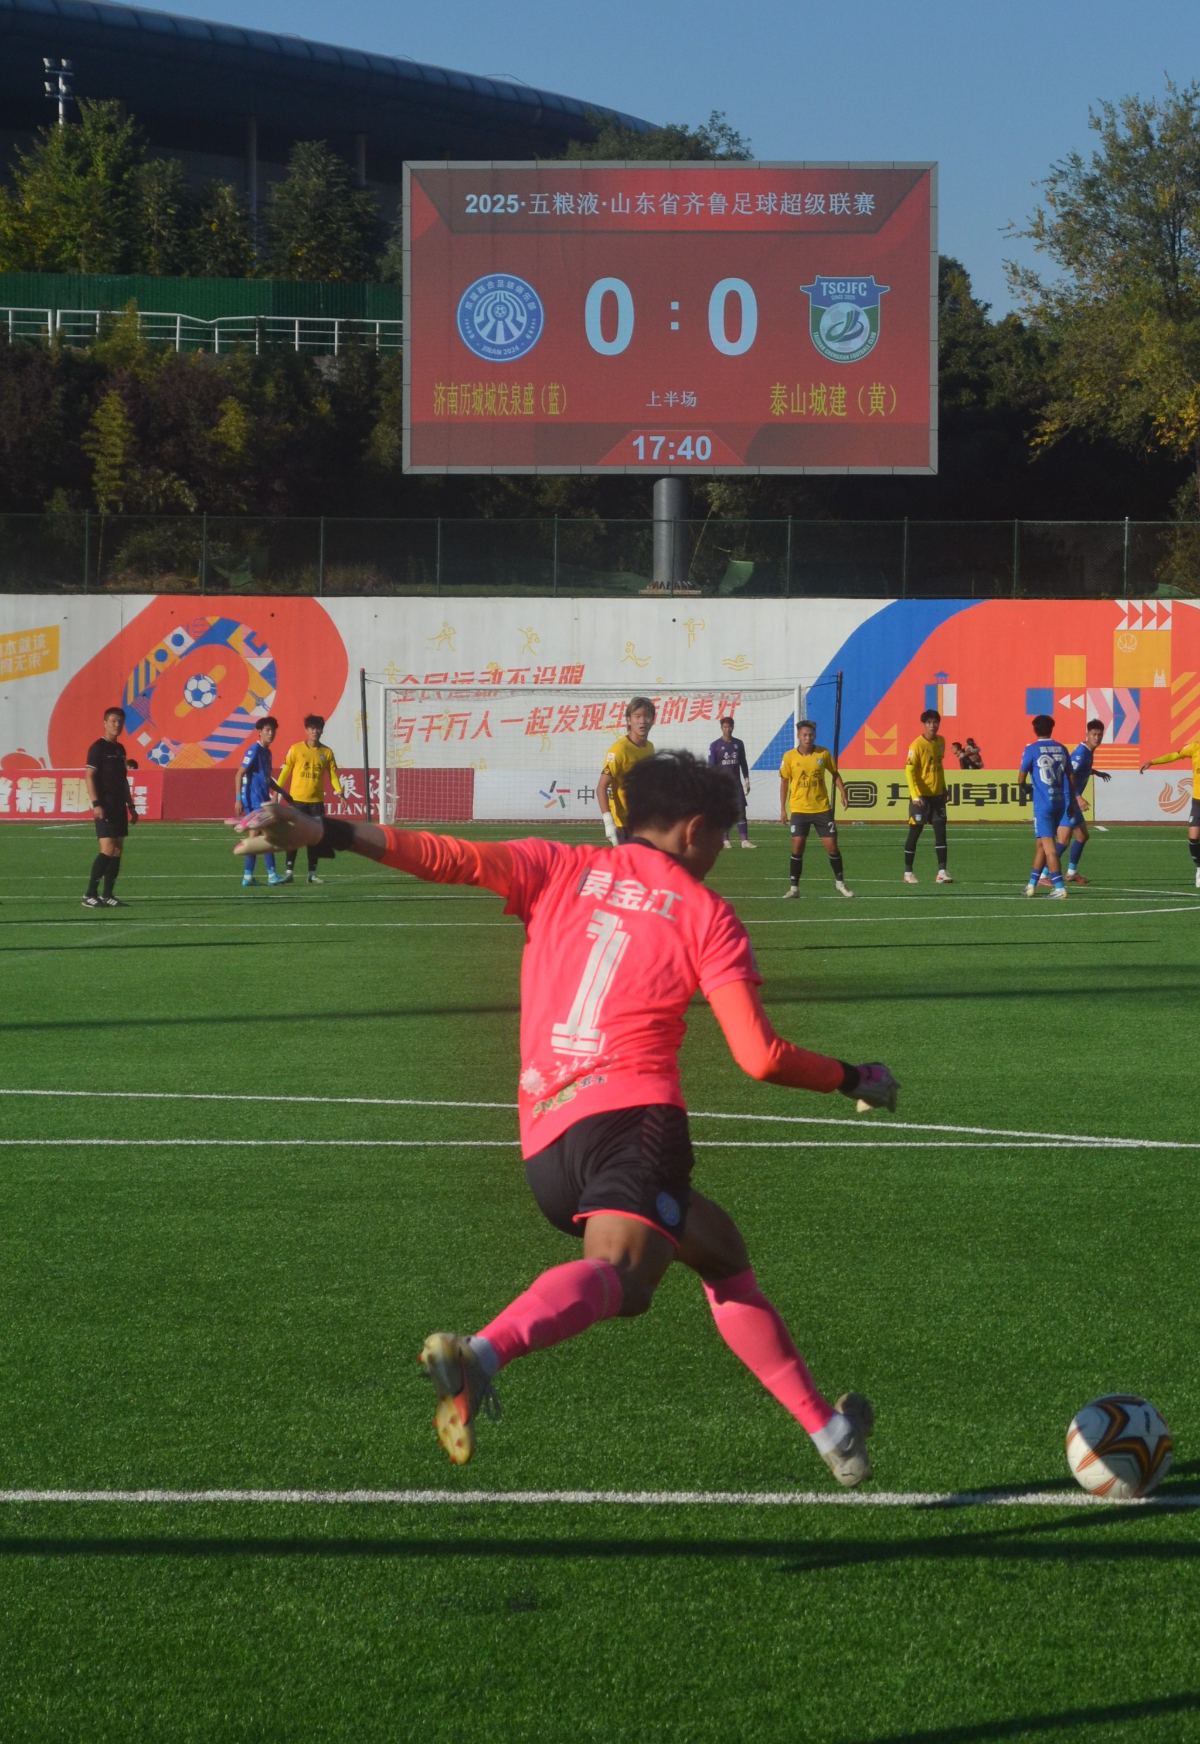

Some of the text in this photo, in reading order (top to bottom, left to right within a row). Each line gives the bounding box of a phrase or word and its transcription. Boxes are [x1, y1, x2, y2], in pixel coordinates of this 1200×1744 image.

[820, 281, 867, 297] TSCJFC
[584, 276, 635, 357] 0
[707, 276, 759, 357] 0
[481, 344, 520, 356] JINAN 2024
[645, 390, 698, 408] 上半场
[632, 434, 713, 462] 17:40
[1036, 754, 1067, 786] 87
[551, 908, 632, 1057] 1
